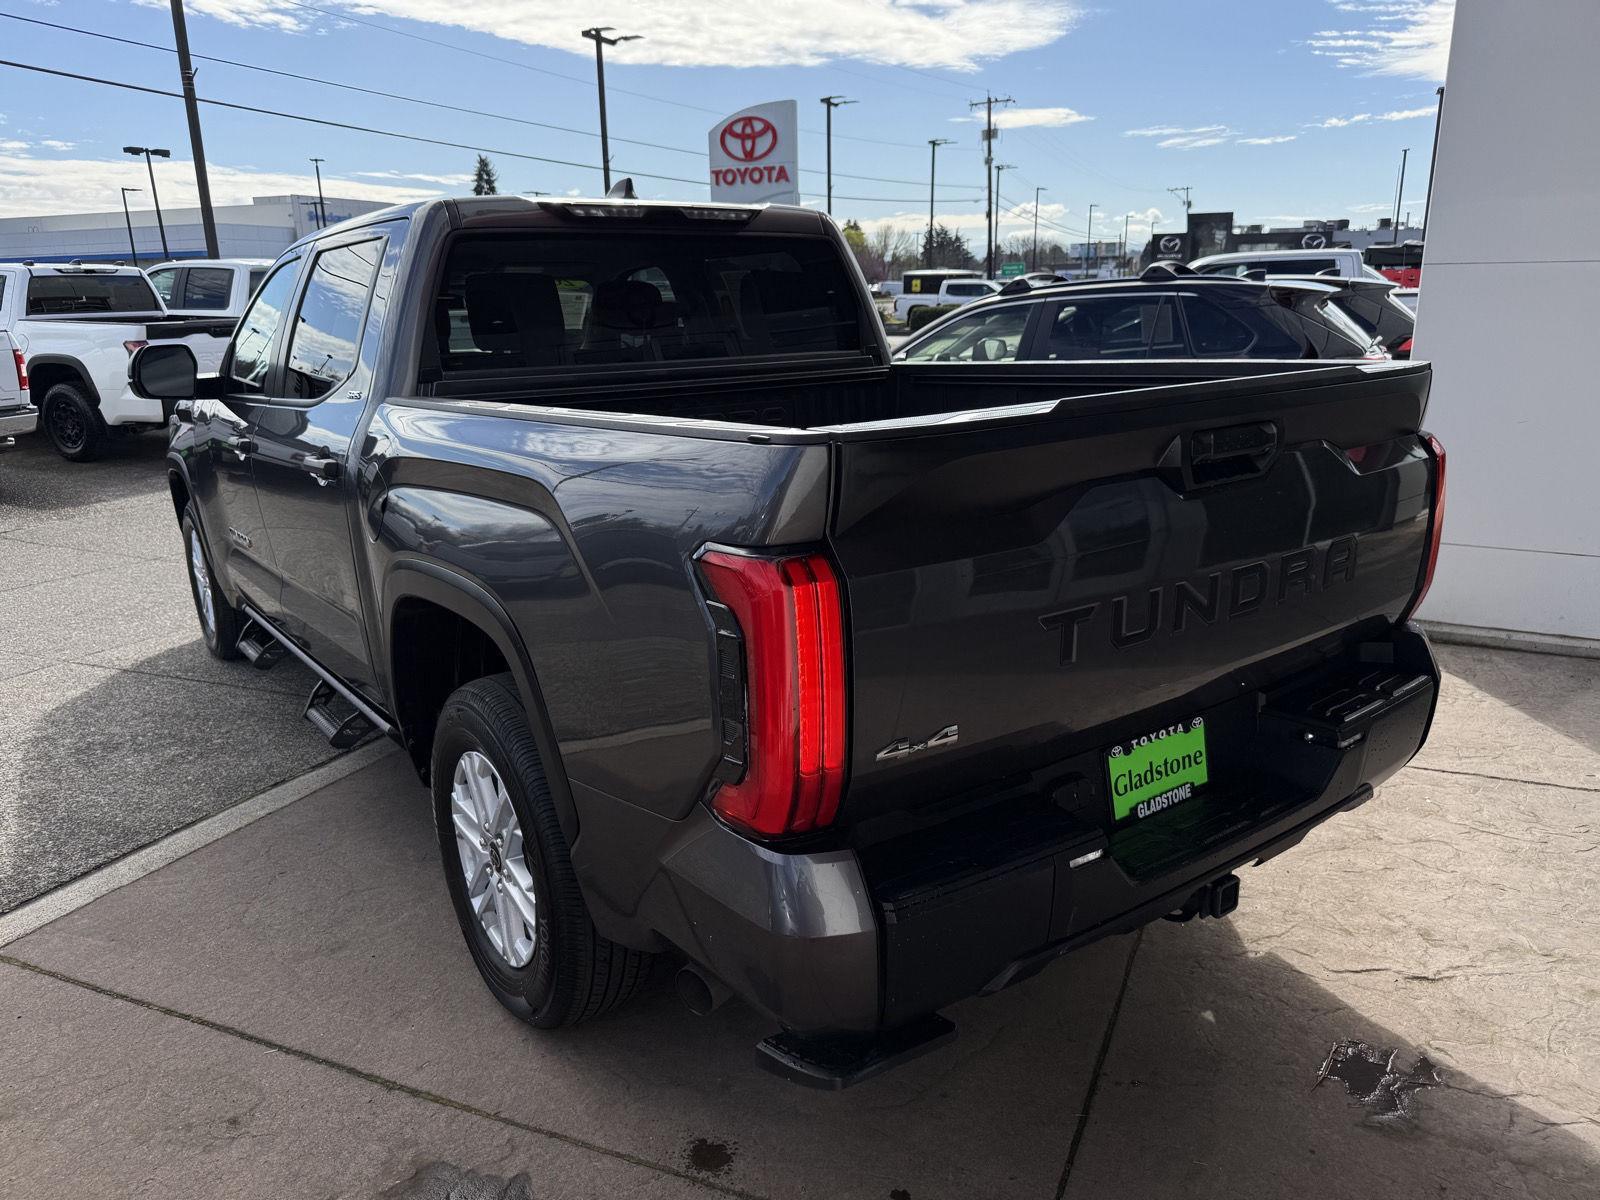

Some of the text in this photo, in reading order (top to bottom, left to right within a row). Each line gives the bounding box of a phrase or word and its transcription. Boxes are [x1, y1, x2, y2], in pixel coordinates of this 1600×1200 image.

[711, 165, 790, 187] TOYOTA
[1038, 532, 1360, 668] TUNDRA
[1131, 723, 1184, 749] TOYOTA
[1113, 750, 1203, 797] Gladstone
[1137, 783, 1192, 819] GLADSTONE
